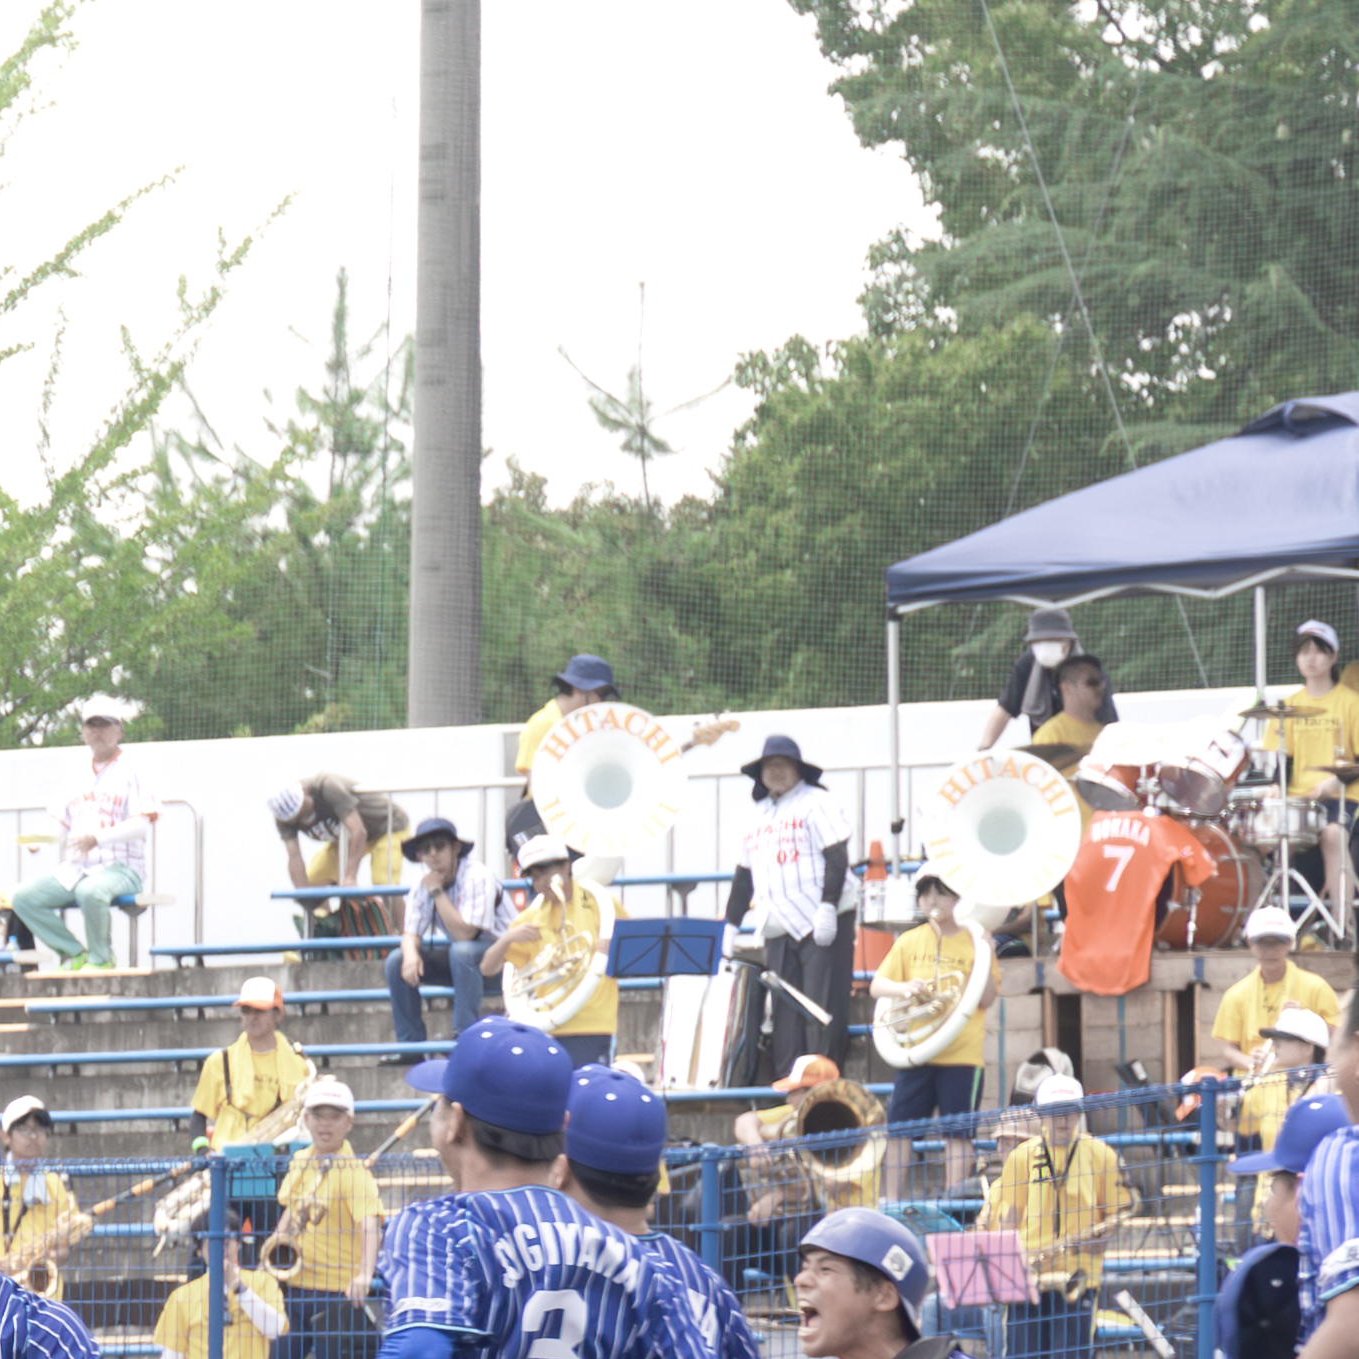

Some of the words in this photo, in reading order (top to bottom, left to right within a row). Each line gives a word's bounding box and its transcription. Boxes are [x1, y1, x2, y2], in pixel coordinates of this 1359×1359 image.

[541, 706, 681, 767] HITACHI
[937, 754, 1076, 818] HITACHI
[1103, 844, 1135, 892] 7
